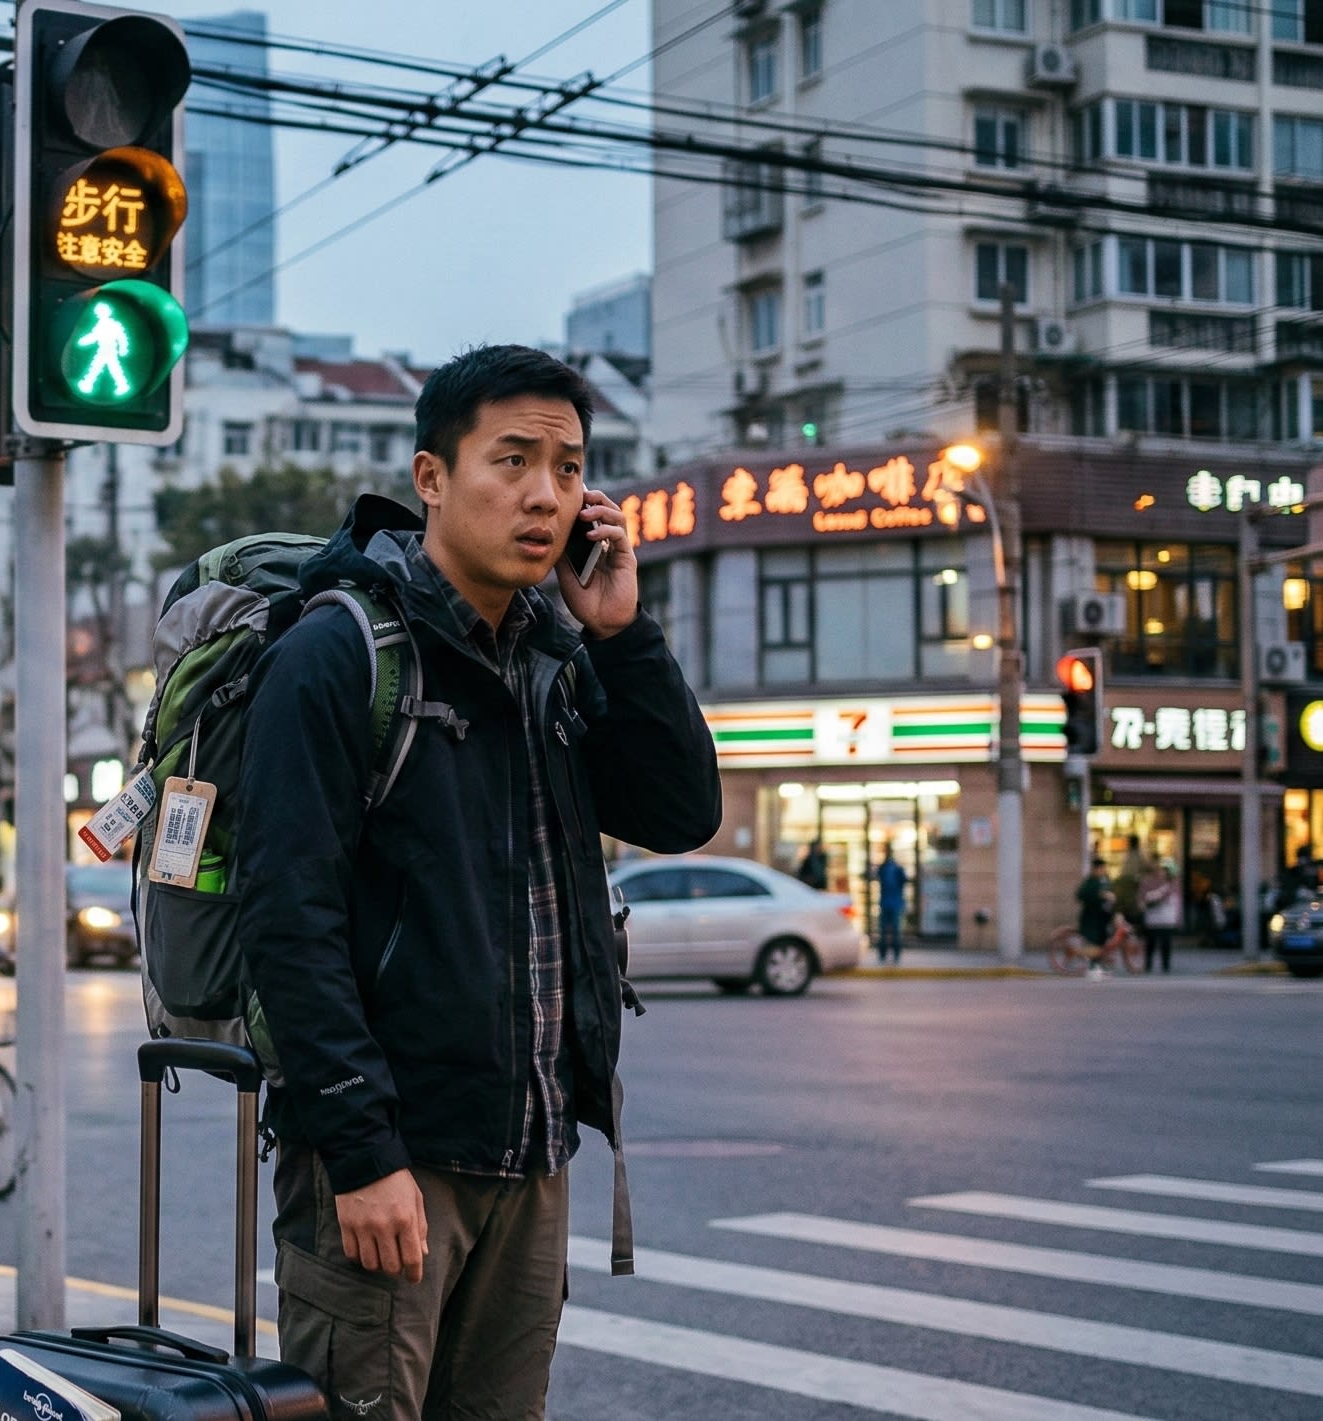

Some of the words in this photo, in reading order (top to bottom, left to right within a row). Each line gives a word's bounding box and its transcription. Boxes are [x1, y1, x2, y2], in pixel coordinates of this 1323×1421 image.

[60, 178, 145, 235] 步行
[56, 231, 149, 270] 注意安全
